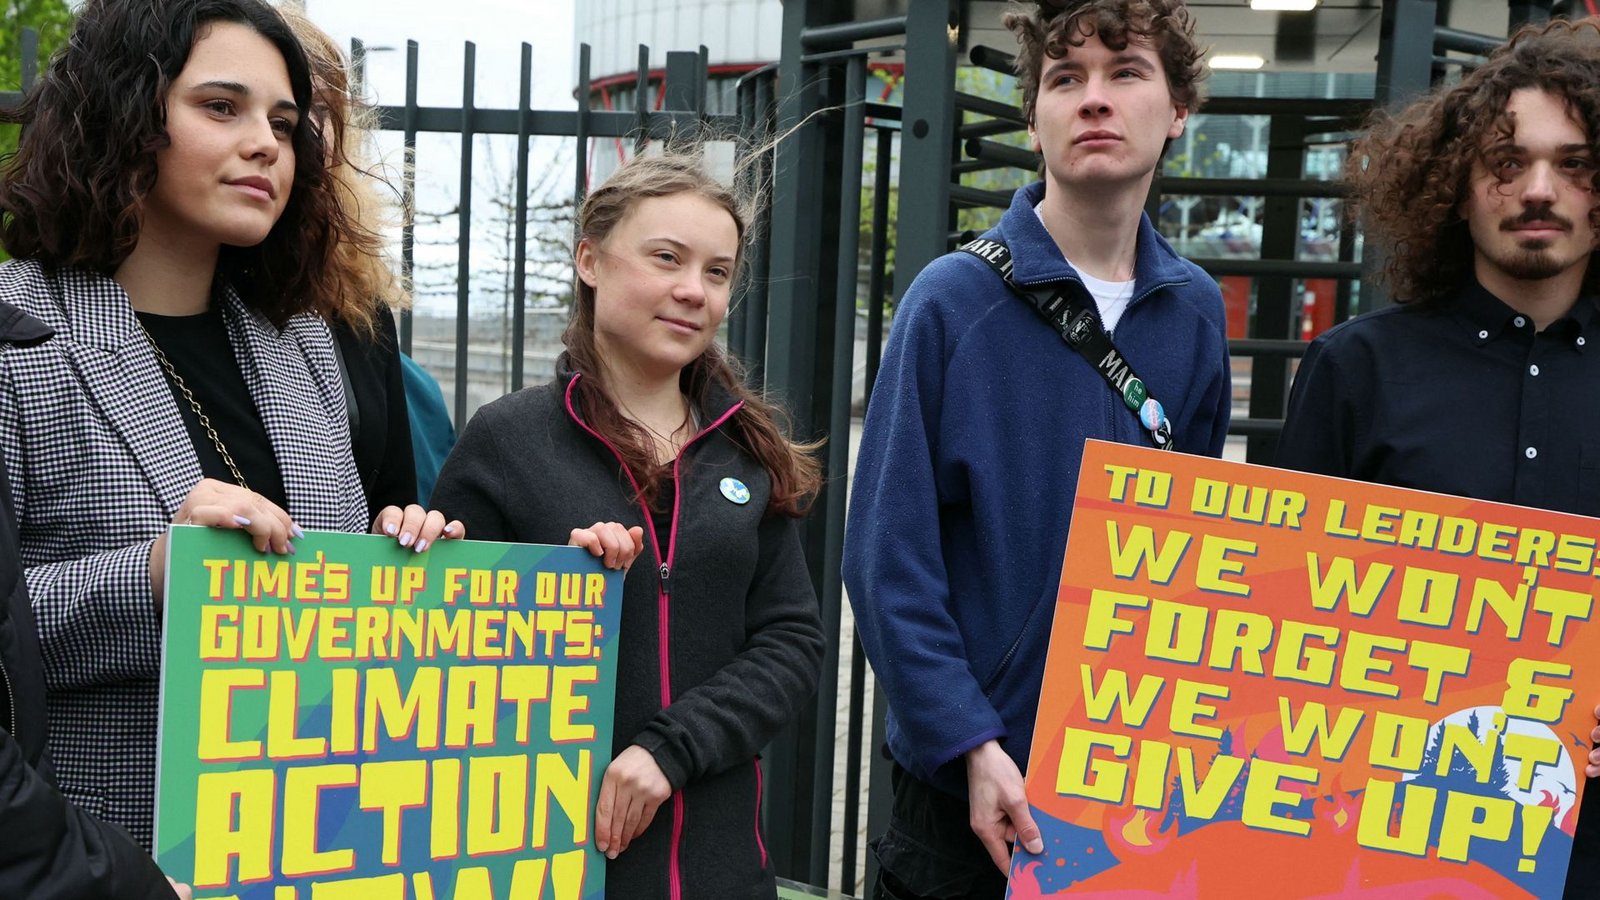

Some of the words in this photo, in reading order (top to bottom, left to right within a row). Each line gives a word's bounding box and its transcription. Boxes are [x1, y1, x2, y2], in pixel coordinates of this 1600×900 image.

[1099, 349, 1134, 393] MA
[1104, 464, 1172, 505] TO
[1191, 478, 1306, 527] OUR
[199, 605, 602, 660] GOVERNMENTS:
[203, 551, 350, 599] TIME'S
[371, 566, 425, 602] UP
[444, 568, 517, 603] FOR
[536, 572, 605, 606] OUR
[1106, 520, 1258, 595] WE
[1307, 552, 1593, 645] WON'T
[1083, 588, 1470, 702] FORGET
[1502, 657, 1574, 723] &
[198, 665, 598, 760] CLIMATE
[1081, 664, 1230, 739] WE
[1279, 697, 1561, 789] WON'T
[194, 749, 591, 886] ACTION
[1056, 727, 1319, 836] GIVE
[1357, 778, 1554, 873] UP!
